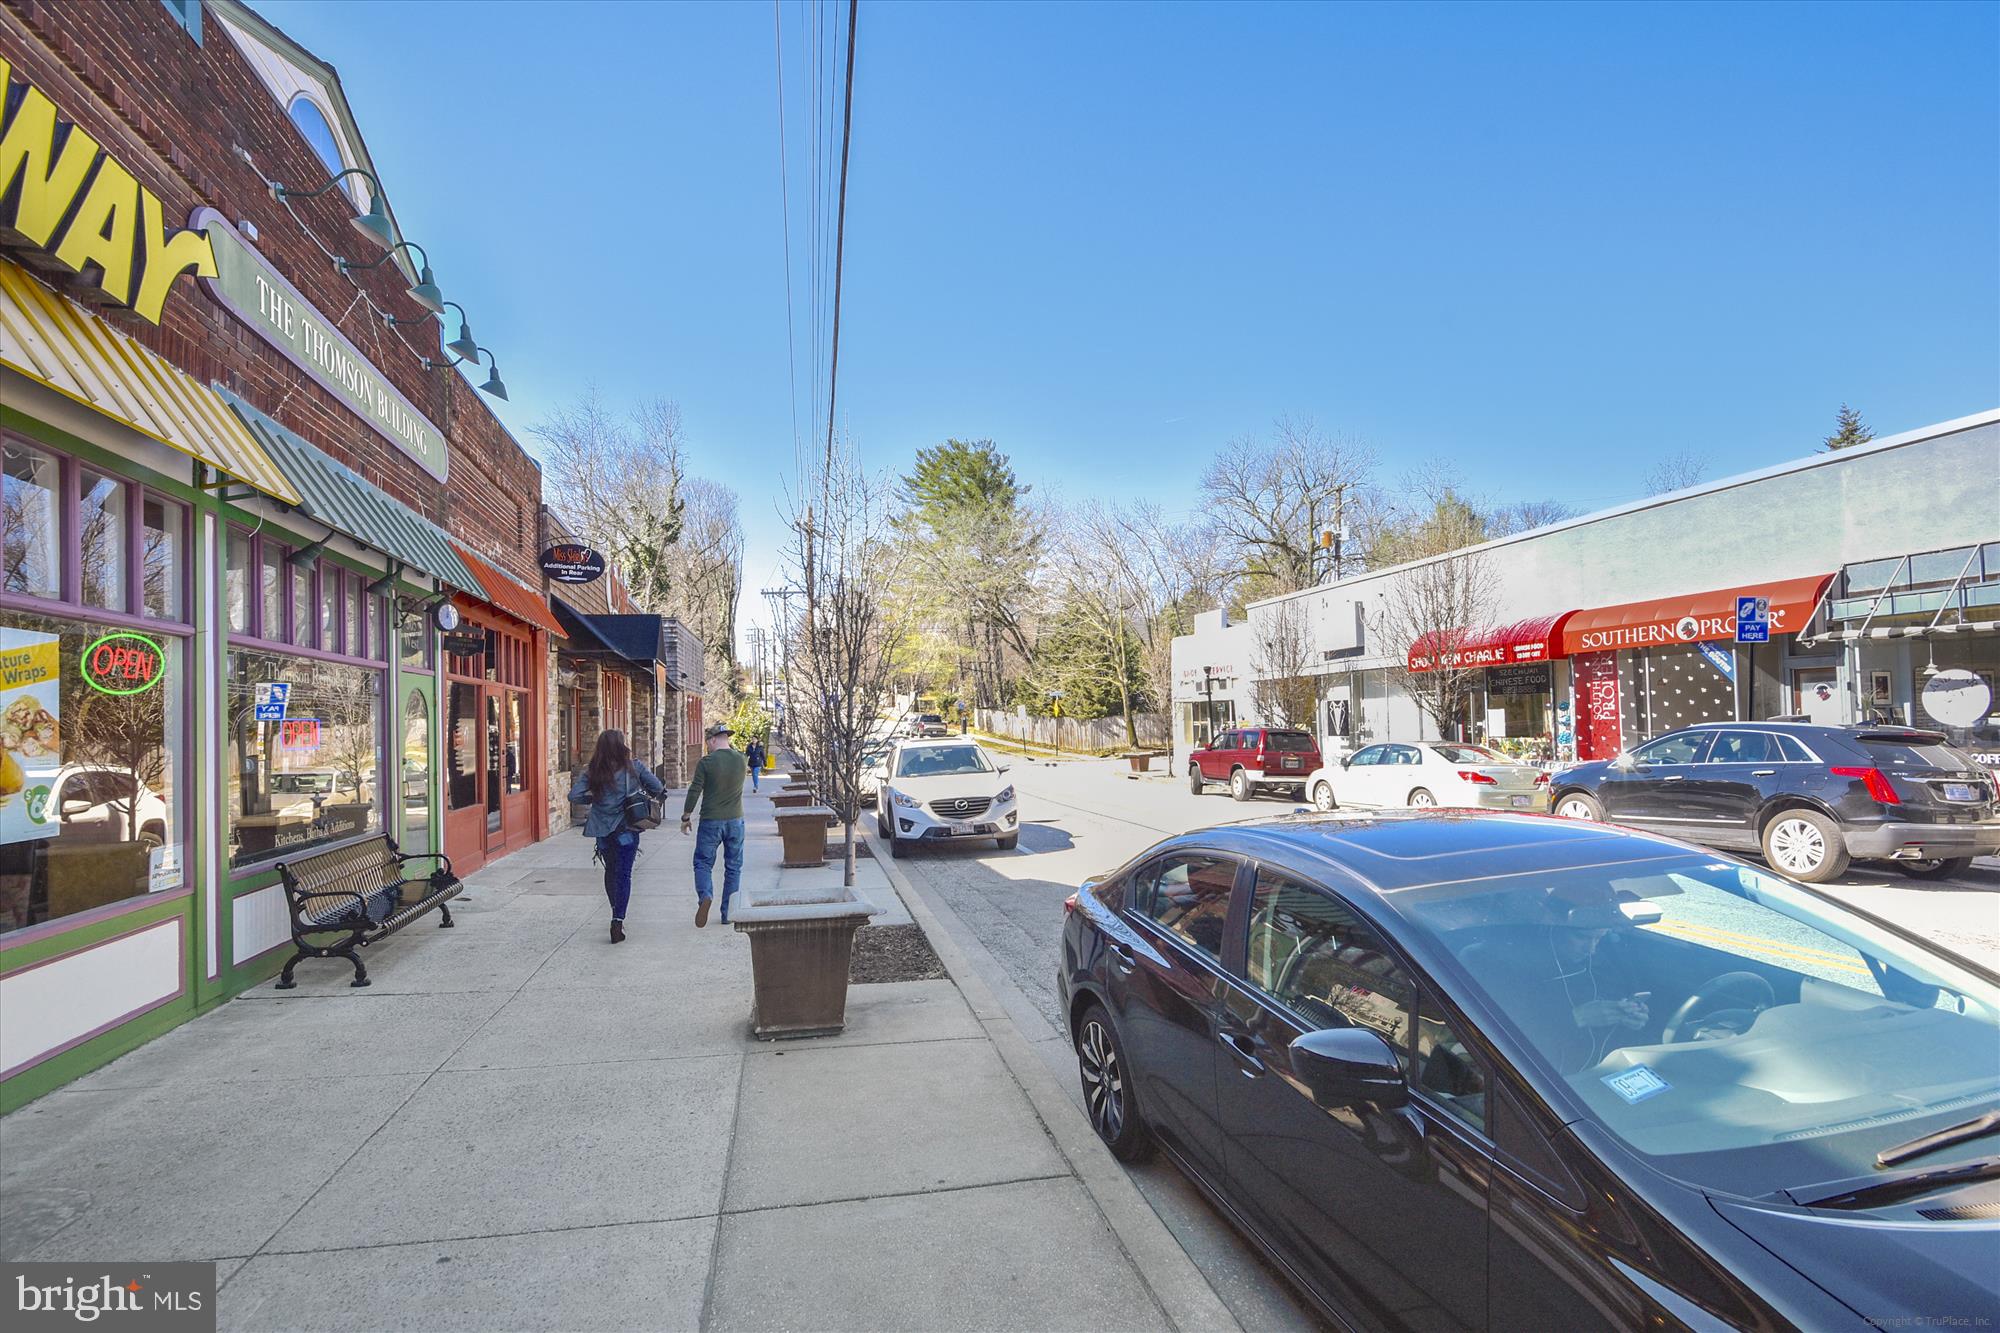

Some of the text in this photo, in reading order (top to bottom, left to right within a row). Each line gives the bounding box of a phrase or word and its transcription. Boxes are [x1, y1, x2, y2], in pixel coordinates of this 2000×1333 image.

[256, 275, 427, 455] THE THOMSON BUILDING
[544, 562, 601, 572] Additional Parking
[1581, 623, 1675, 649] SOUTHERN
[0, 653, 31, 671] ture
[93, 644, 154, 683] OPEN
[1464, 648, 1504, 661] CHARLIE
[3, 666, 47, 684] Wraps
[1491, 674, 1547, 687] CHINESE FOOD
[1601, 652, 1616, 720] PROPER
[1592, 657, 1603, 720] SOUTHERN
[282, 721, 319, 748] OPEN
[274, 830, 306, 848] Kitchens,
